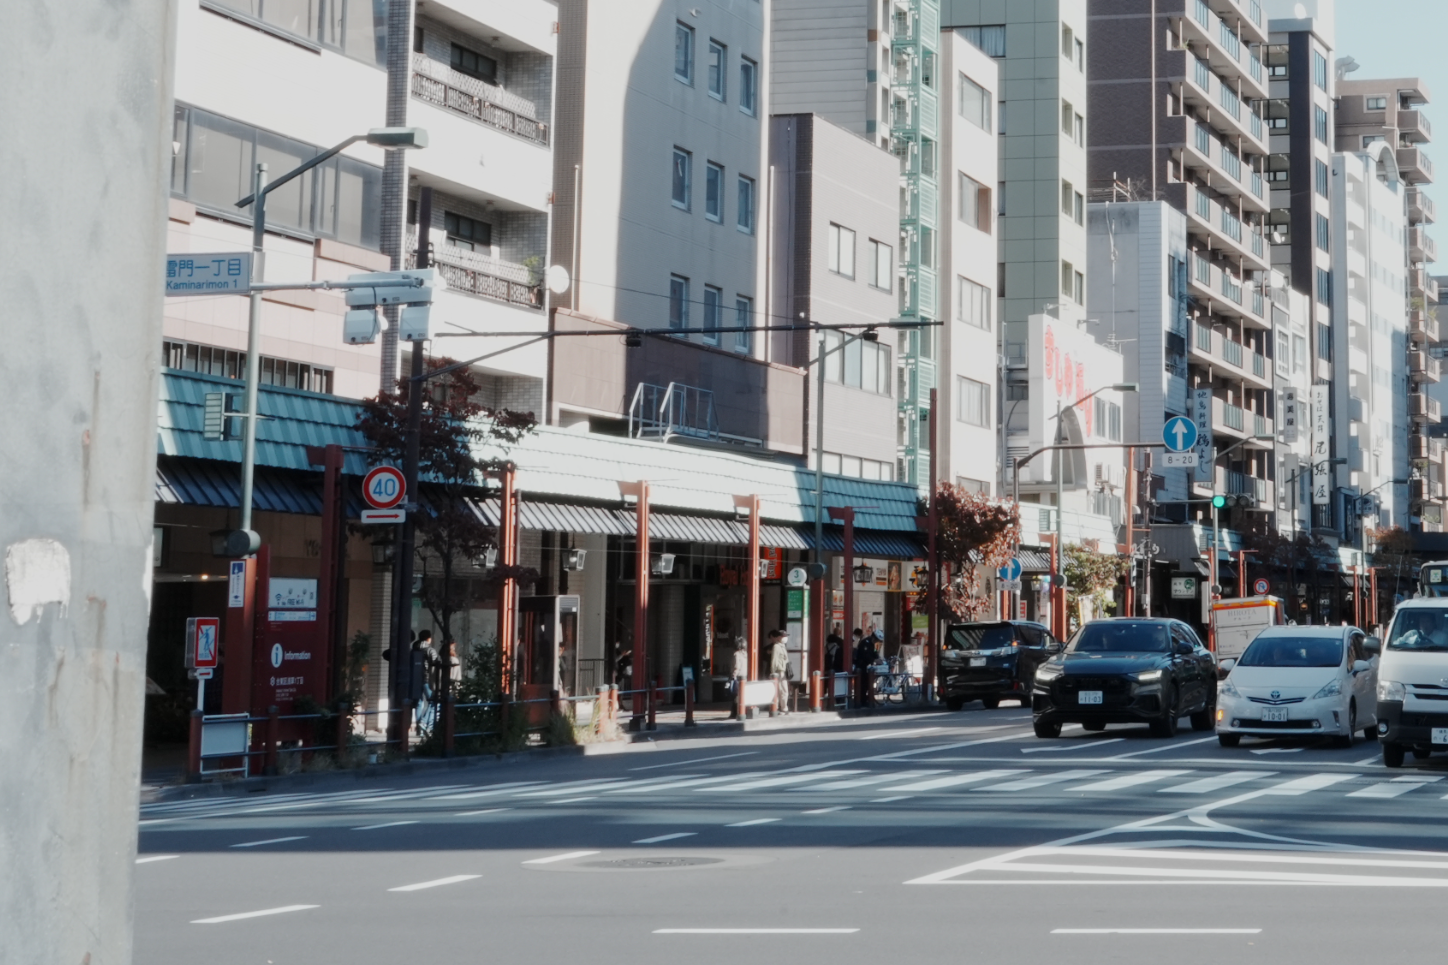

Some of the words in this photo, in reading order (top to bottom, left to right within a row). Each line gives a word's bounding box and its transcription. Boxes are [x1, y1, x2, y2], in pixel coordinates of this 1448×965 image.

[166, 279, 229, 290] Kaminarimon
[233, 278, 237, 288] 1
[373, 478, 396, 497] 40
[1227, 608, 1257, 616] HIROTA
